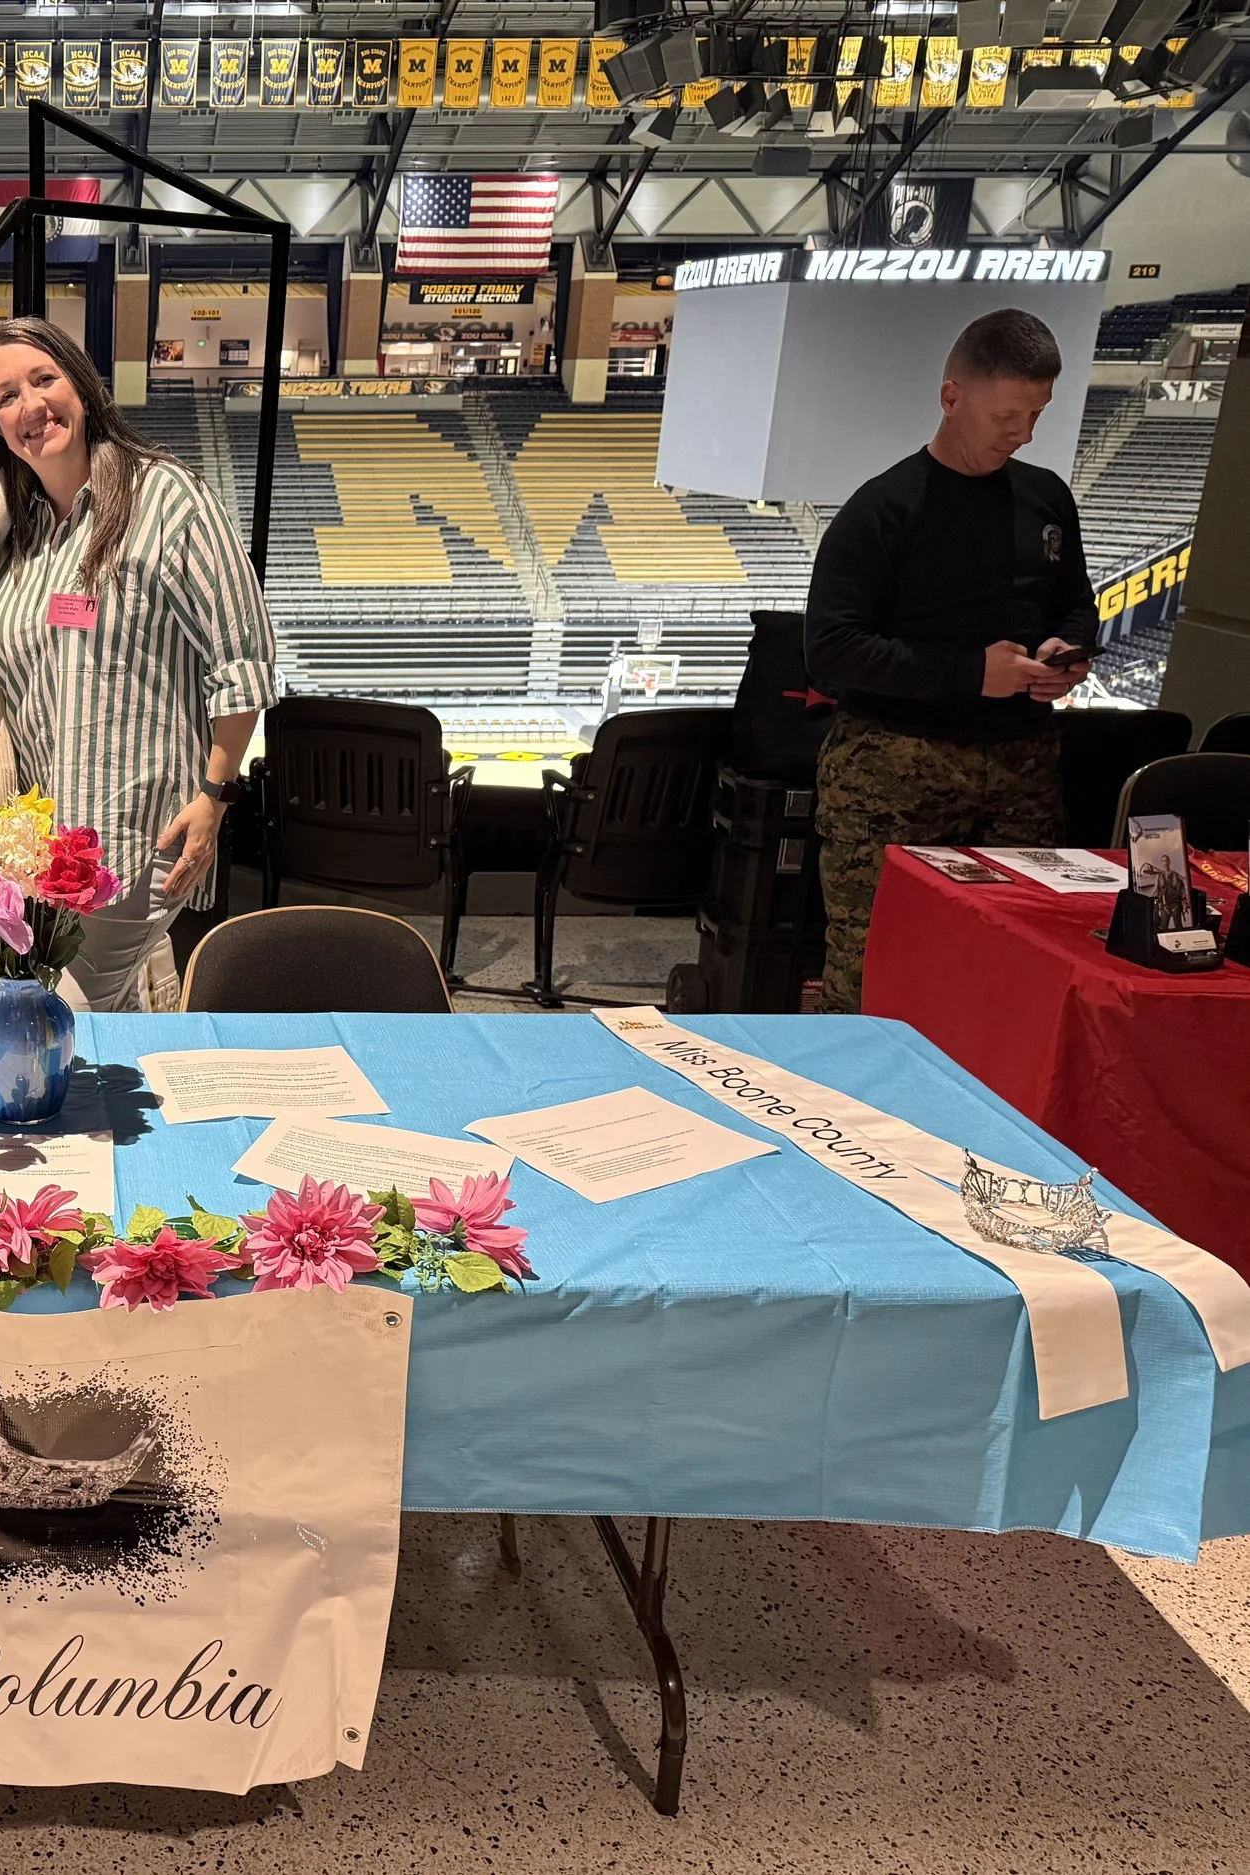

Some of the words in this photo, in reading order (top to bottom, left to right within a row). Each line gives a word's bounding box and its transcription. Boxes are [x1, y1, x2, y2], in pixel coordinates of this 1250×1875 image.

[22, 49, 45, 59] NCAA
[71, 50, 94, 59] NCAA
[118, 49, 141, 58] NCAA
[933, 49, 955, 57] NCAA
[982, 47, 1005, 55] NCAA
[169, 59, 189, 75] M
[220, 58, 239, 75] M
[269, 58, 290, 74] M
[316, 58, 336, 74] M
[363, 58, 382, 74] M
[408, 59, 426, 73] M
[455, 59, 473, 73] M
[501, 59, 520, 73] M
[548, 59, 567, 73] M
[162, 76, 195, 90] CHAMPIONS
[213, 76, 245, 89] CHAMPIONS
[263, 76, 295, 89] CHAMPIONS
[309, 76, 342, 89] CHAMPIONS
[356, 76, 388, 89] CHAMPIONS
[400, 76, 432, 88] CHAMPIONS
[447, 76, 479, 89] CHAMPIONS
[494, 76, 525, 88] CHAMPIONS
[541, 76, 572, 88] CHAMPIONS
[713, 252, 783, 286] ARENA
[805, 250, 971, 281] MIZZOU
[972, 250, 1106, 281] ARENA
[1132, 266, 1157, 277] 219
[420, 284, 476, 294] ROBERTS
[479, 284, 525, 294] FAMILY
[423, 294, 473, 303] STUDENT
[474, 294, 520, 303] SECTION
[654, 1040, 717, 1067] Miss
[706, 1066, 797, 1117] Boone
[792, 1116, 909, 1180] County
